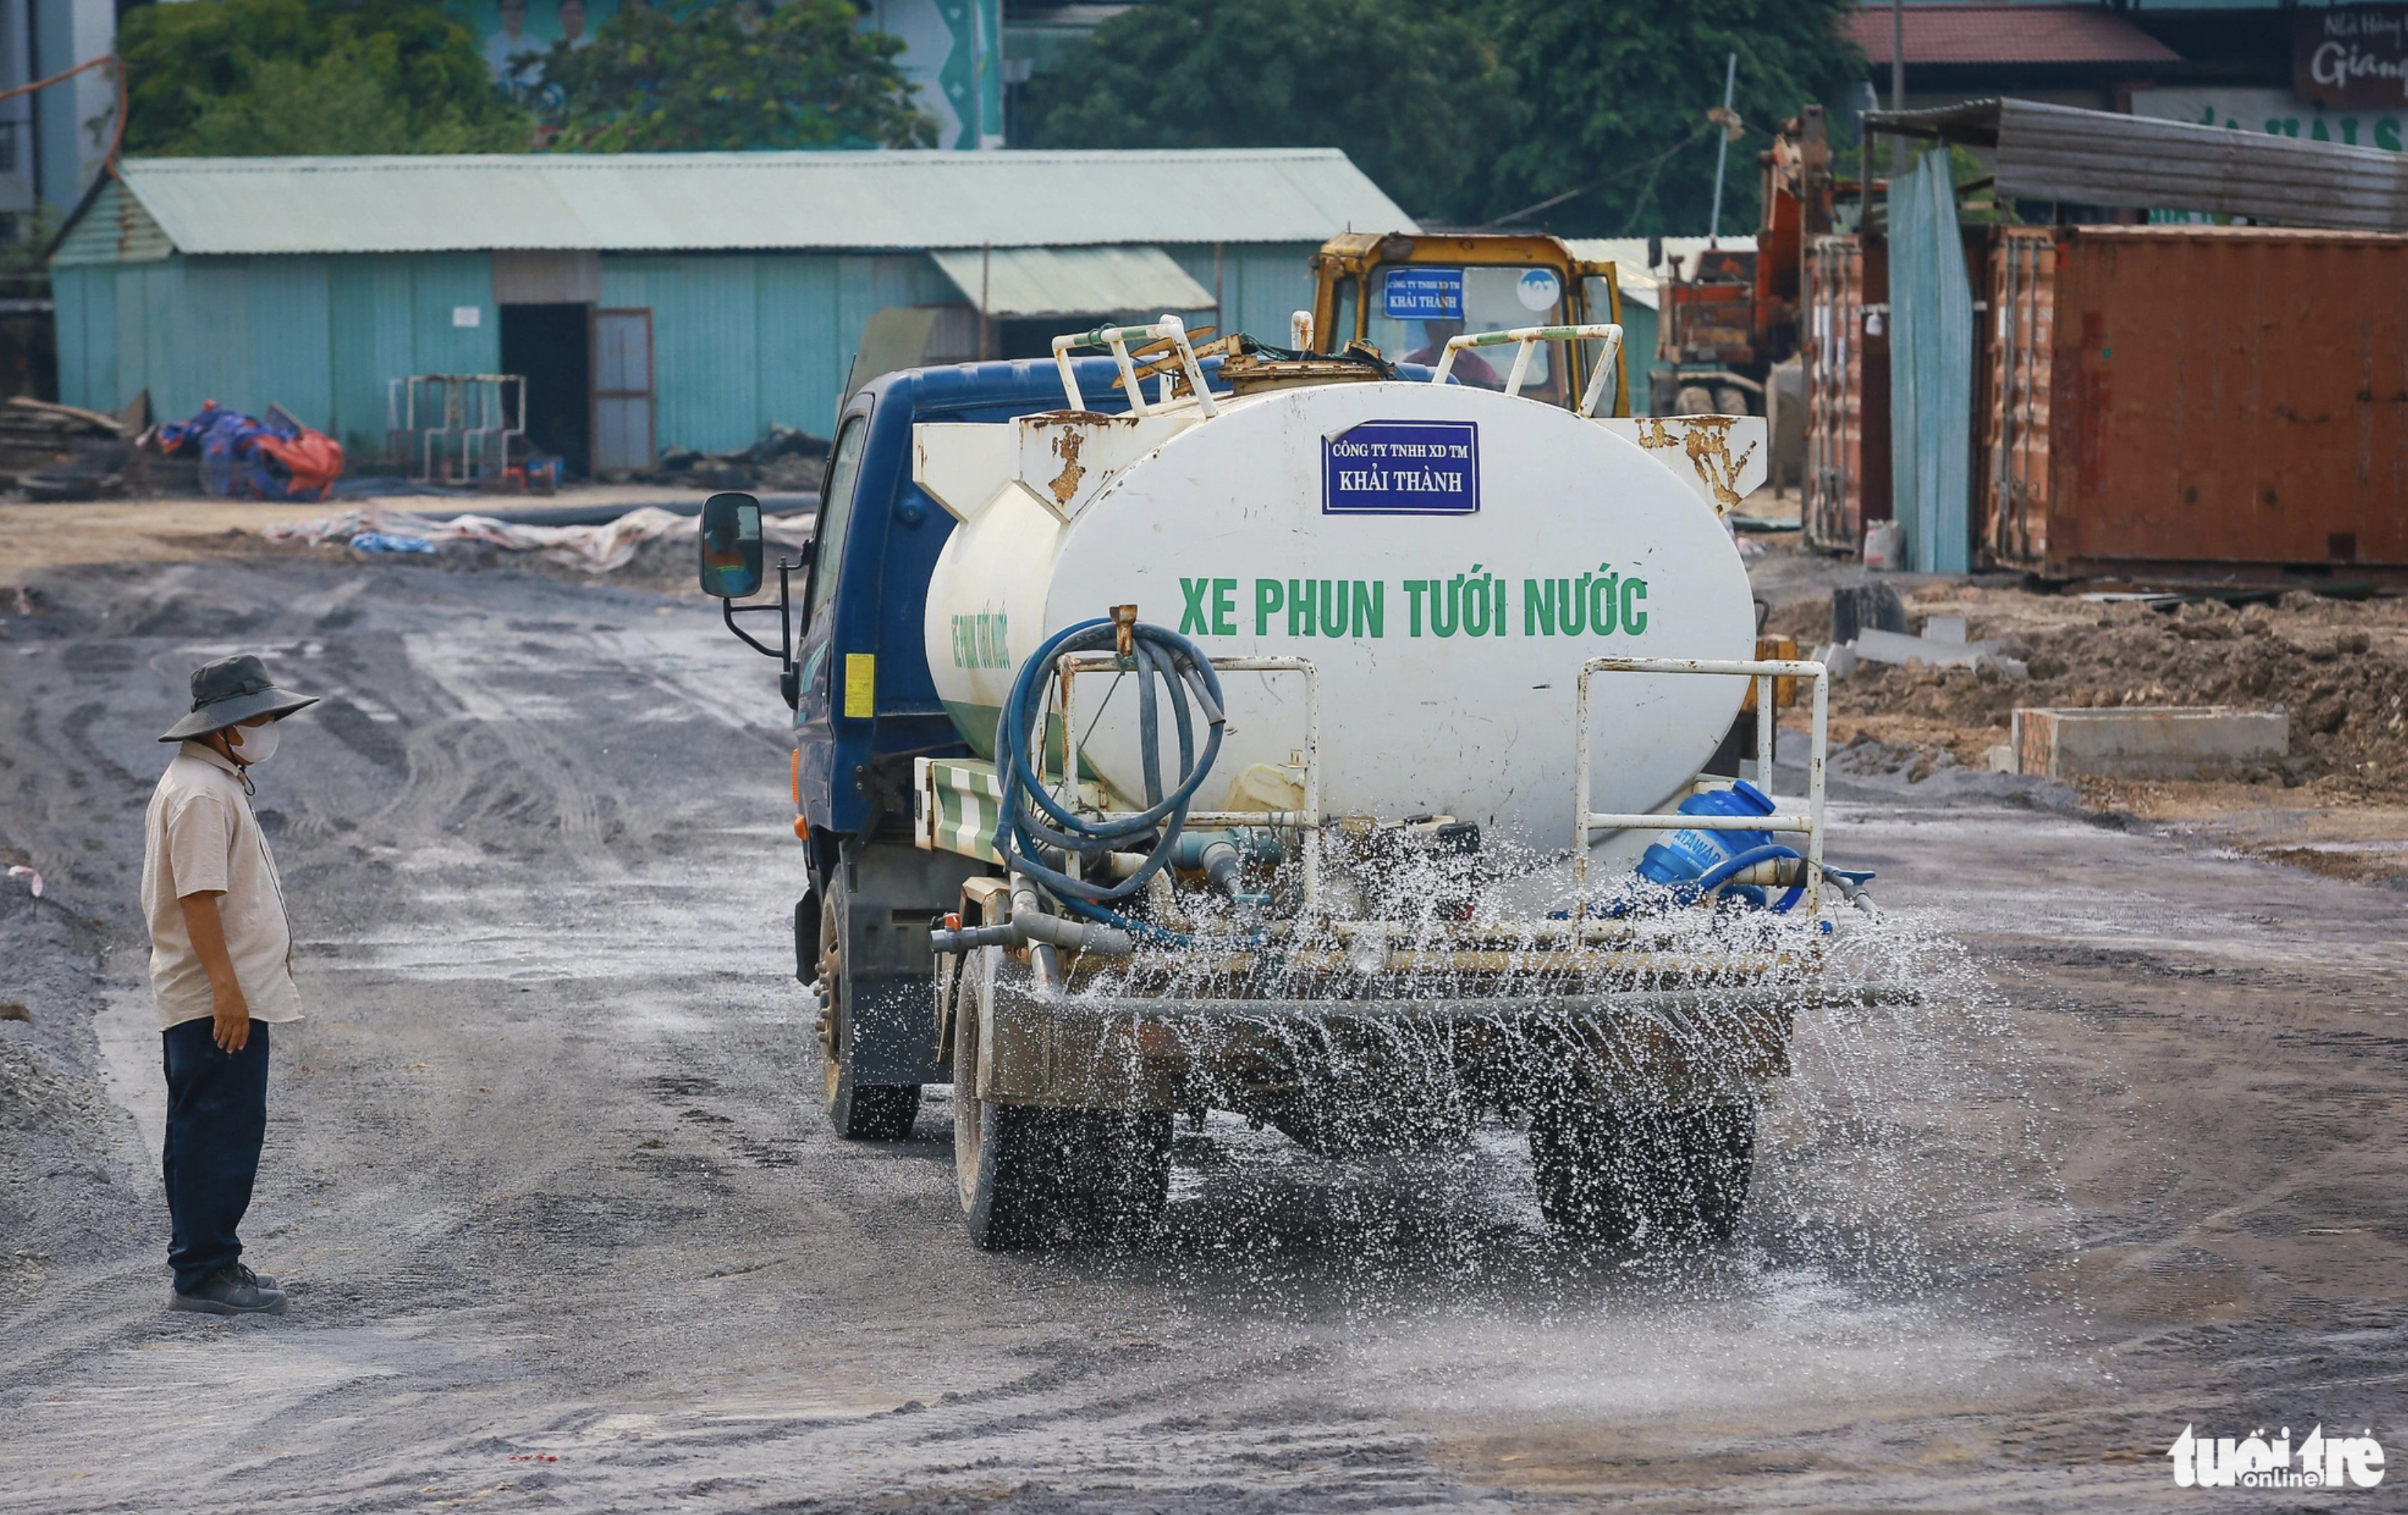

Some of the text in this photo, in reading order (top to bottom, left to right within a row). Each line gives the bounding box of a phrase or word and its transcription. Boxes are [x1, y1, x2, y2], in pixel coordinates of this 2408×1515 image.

[1390, 291, 1417, 308] KHẢI
[1333, 440, 1468, 459] CÔNG TY TNHH XD TM
[1339, 463, 1463, 492] KHẢI THÀNH
[1178, 562, 1648, 638] XE PHUN TƯỚI NƯỚC
